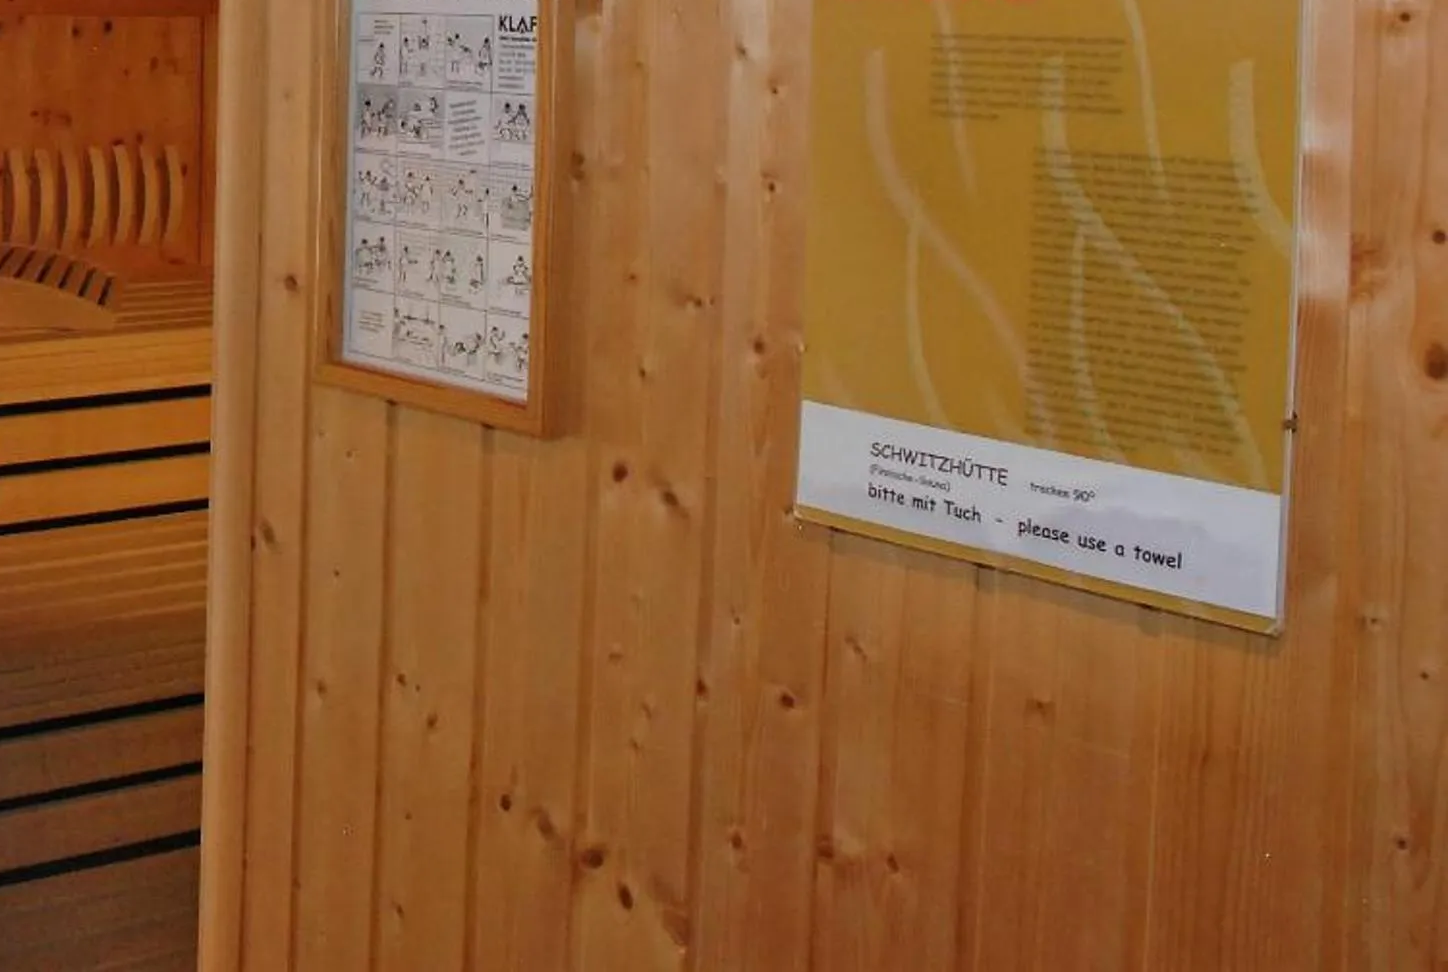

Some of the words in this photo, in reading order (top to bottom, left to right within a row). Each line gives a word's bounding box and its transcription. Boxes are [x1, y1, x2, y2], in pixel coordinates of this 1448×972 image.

[870, 442, 1008, 486] SCHWITZHÜTTE
[868, 482, 904, 505] bitte
[912, 495, 936, 512] mit
[944, 500, 981, 523] Tuch
[1018, 518, 1070, 544] please
[1078, 535, 1107, 552] use
[1114, 544, 1125, 557] a
[1134, 546, 1183, 569] towel
